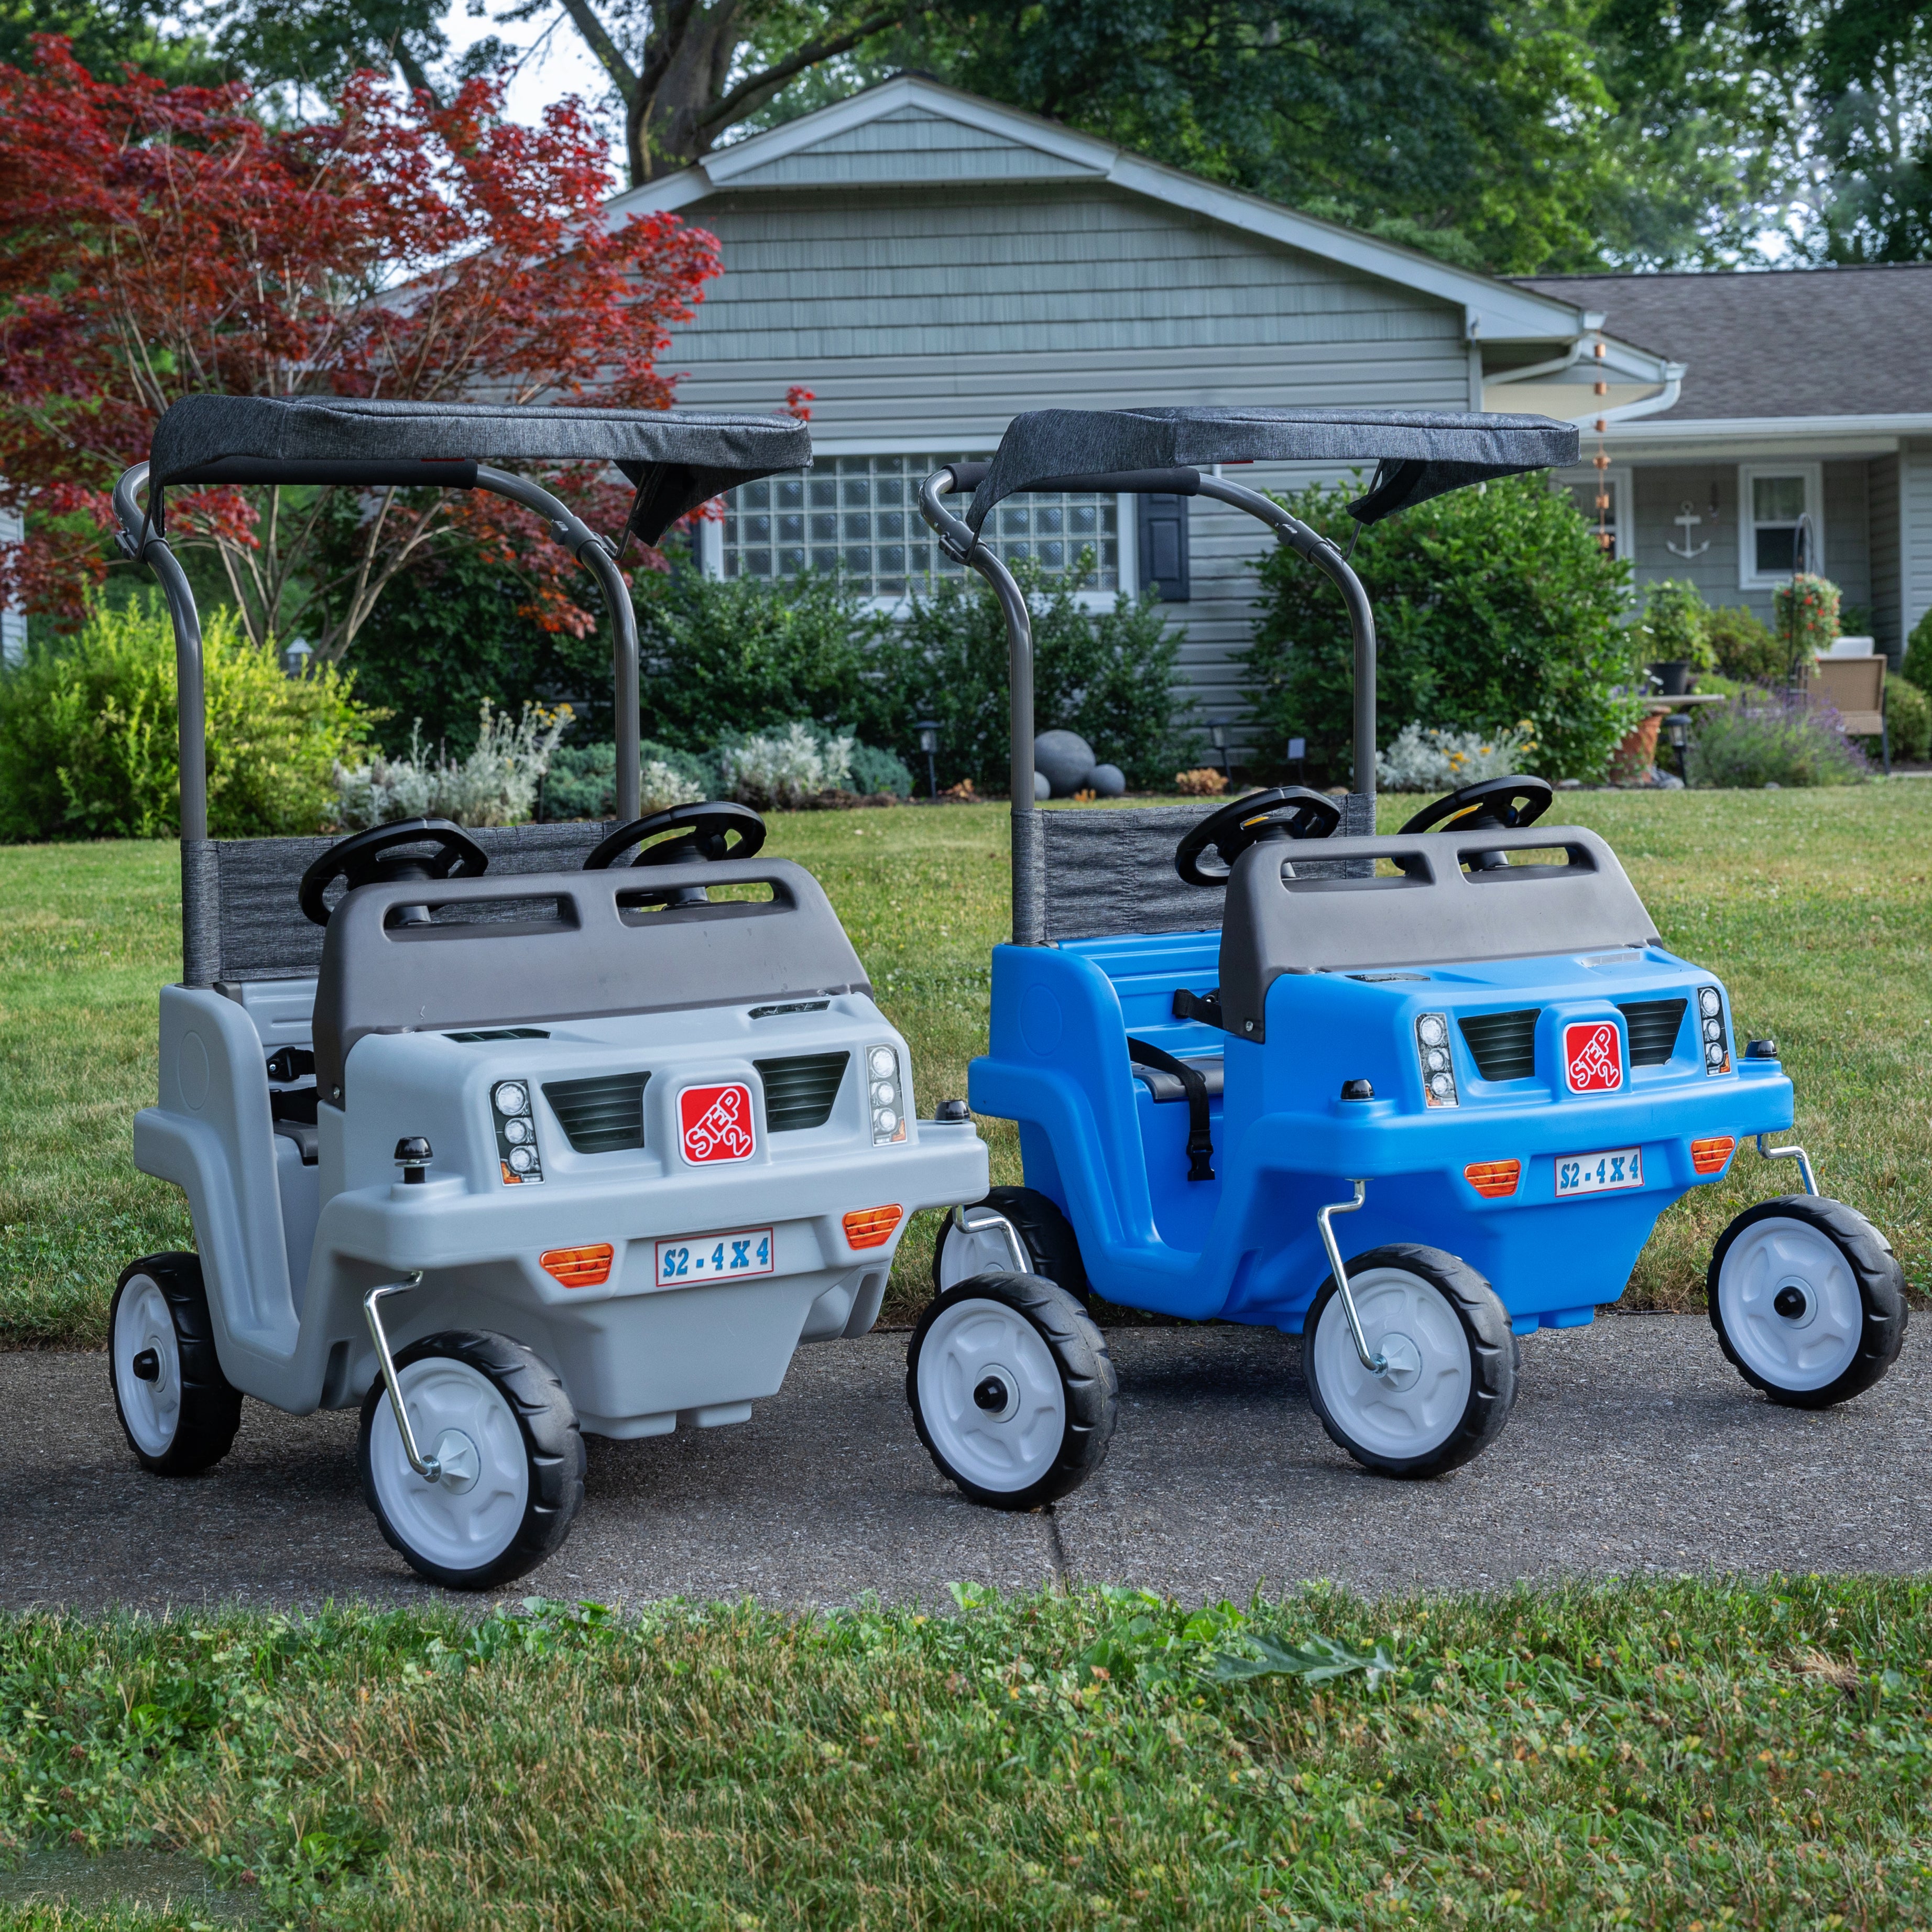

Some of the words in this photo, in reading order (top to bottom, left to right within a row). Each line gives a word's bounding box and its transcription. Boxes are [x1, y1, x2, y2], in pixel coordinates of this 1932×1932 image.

[1570, 1027, 1611, 1087] STEP
[1598, 1059, 1619, 1086] 2
[686, 1088, 740, 1158] STEP
[724, 1125, 750, 1156] 2
